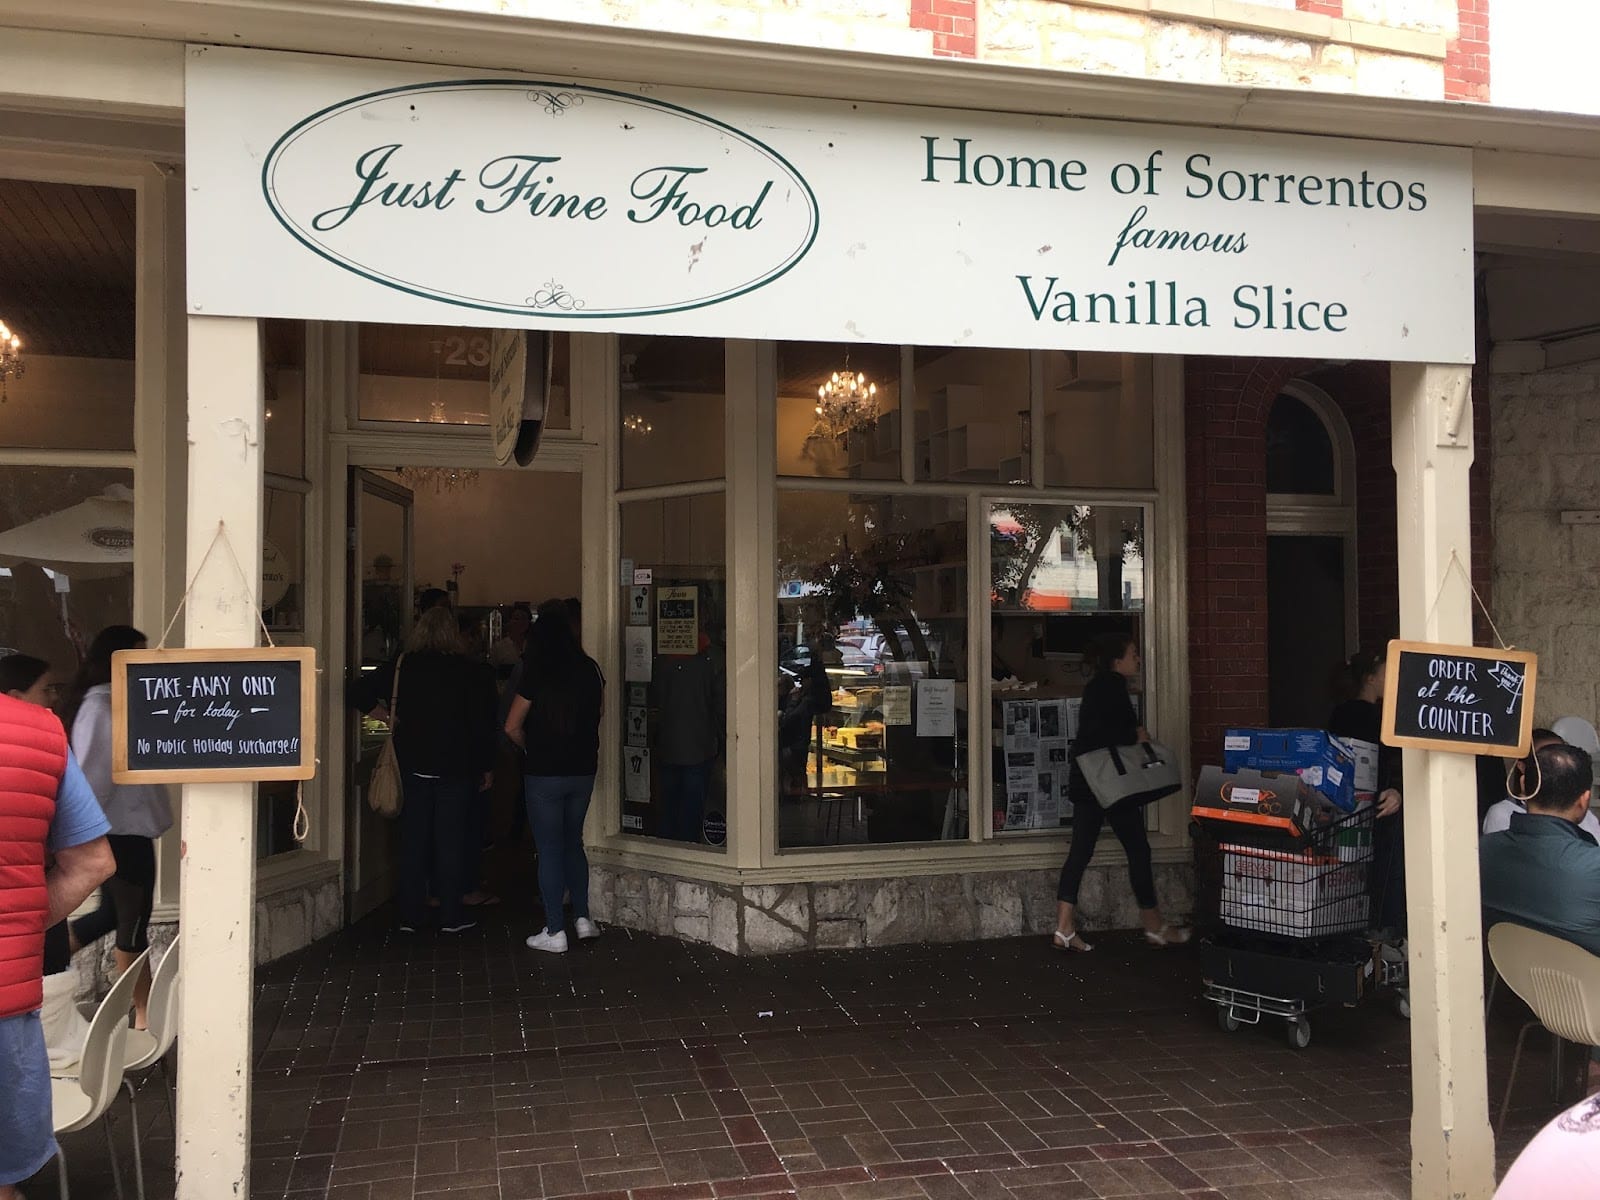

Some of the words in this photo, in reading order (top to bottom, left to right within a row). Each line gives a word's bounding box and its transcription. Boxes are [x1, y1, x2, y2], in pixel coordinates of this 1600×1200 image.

[312, 144, 465, 230] Just
[476, 155, 607, 221] Fine
[627, 166, 774, 230] Food
[920, 135, 1087, 192] Home
[1110, 149, 1163, 197] of
[1184, 153, 1428, 211] Sorrentos
[1108, 205, 1249, 265] famous
[1015, 275, 1210, 329] Vanilla
[1233, 284, 1348, 332] Slice
[1429, 659, 1478, 681] ORDER
[242, 676, 276, 696] ONLY
[1417, 681, 1440, 698] at
[1444, 685, 1482, 704] the
[174, 700, 195, 724] for
[203, 701, 243, 730] today
[1418, 704, 1494, 737] COUNTER
[137, 739, 150, 755] No
[193, 738, 233, 755] Holiday
